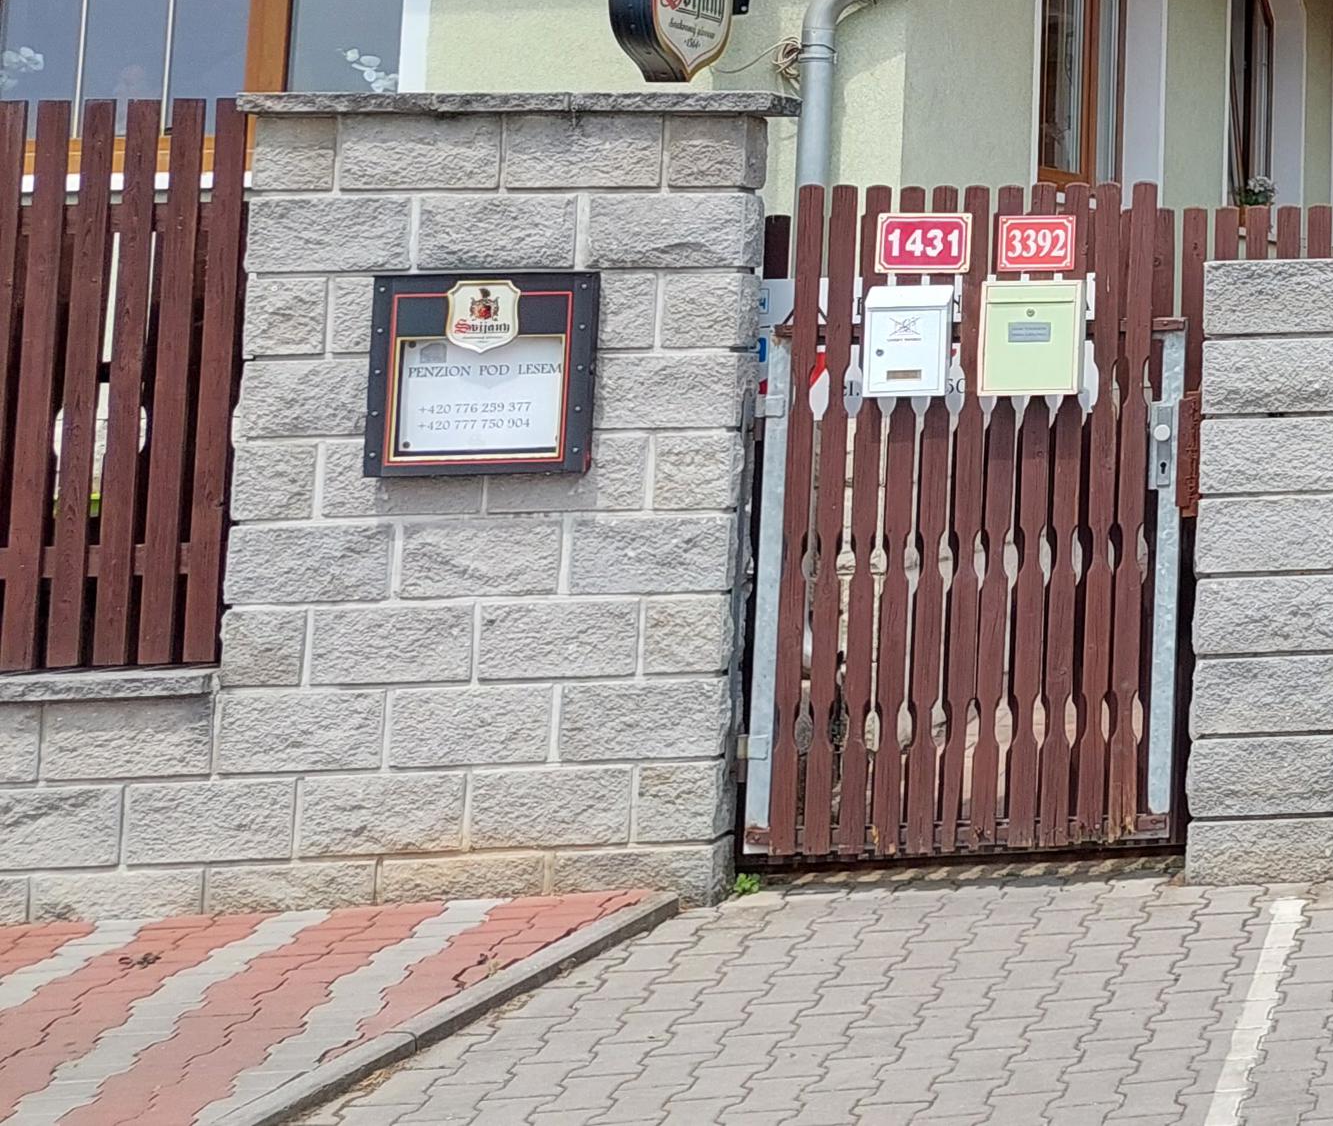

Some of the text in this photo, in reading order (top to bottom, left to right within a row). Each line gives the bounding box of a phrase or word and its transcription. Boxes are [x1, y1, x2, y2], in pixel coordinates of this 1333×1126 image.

[888, 228, 960, 257] 1431
[1007, 228, 1067, 258] 3392
[455, 318, 511, 334] Svijany
[408, 362, 562, 378] PENZION POD LESEM
[418, 403, 452, 415] +420
[455, 402, 478, 414] 776
[508, 400, 532, 412] 377
[417, 417, 530, 431] +420 777 750 904
